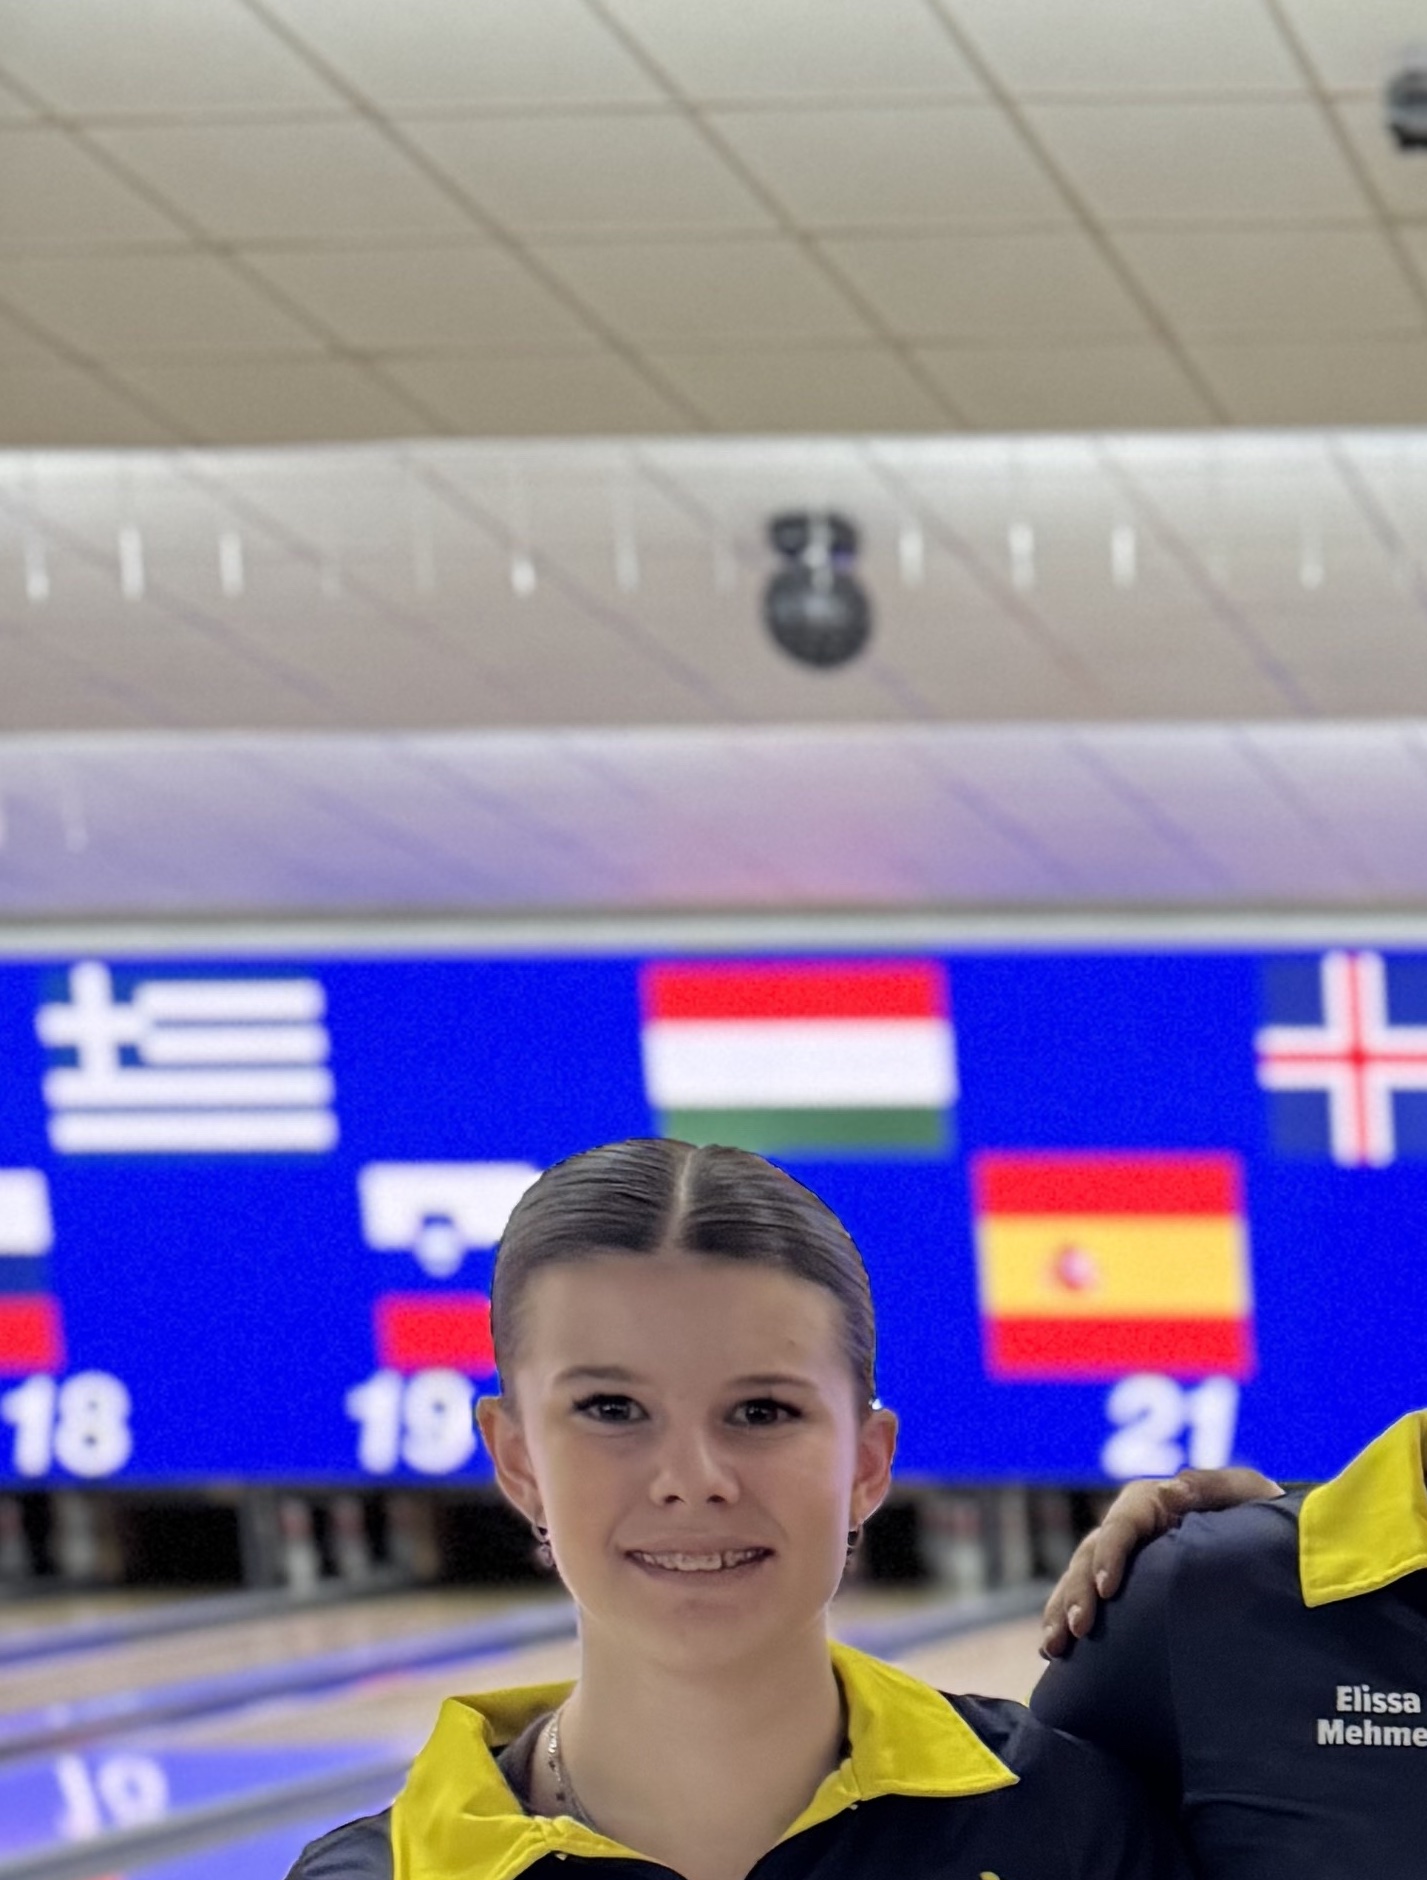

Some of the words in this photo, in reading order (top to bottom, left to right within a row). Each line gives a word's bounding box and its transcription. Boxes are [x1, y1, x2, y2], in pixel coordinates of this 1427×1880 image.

[0, 1369, 134, 1479] 18
[1101, 1372, 1240, 1480] 21
[1336, 1684, 1421, 1714] Elissa
